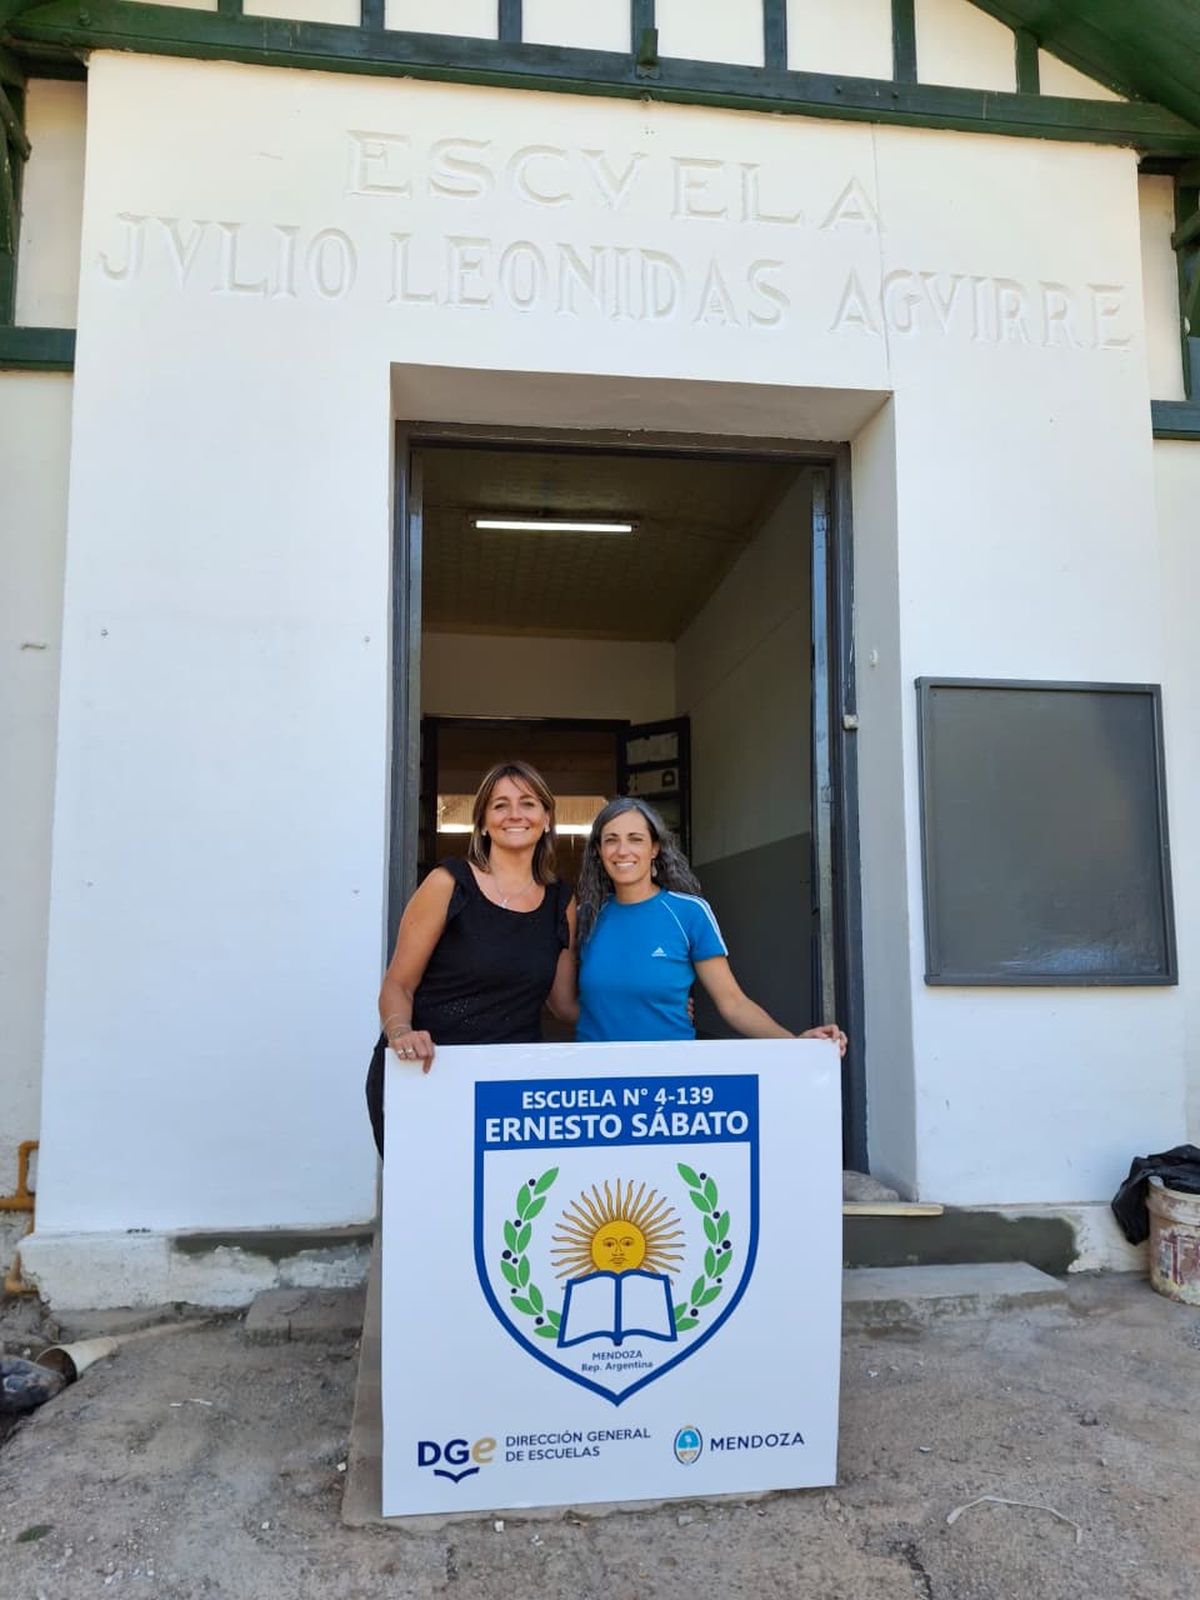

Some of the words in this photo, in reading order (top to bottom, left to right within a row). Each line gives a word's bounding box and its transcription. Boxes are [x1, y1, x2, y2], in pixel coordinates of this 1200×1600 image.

[98, 211, 357, 302] JVLIO
[388, 230, 791, 332] LEONIDAS
[828, 267, 1132, 351] AGVIRRE
[521, 1088, 616, 1110] ESCUELA
[654, 1086, 714, 1106] 4-139
[485, 1114, 623, 1143] ERNESTO
[631, 1106, 749, 1138] SÁBATO
[591, 1350, 643, 1361] MENDOZA
[581, 1363, 602, 1373] Rep.
[605, 1361, 653, 1372] Argentina
[506, 1430, 582, 1447] DIRECCIÓN
[586, 1427, 651, 1443] GENERAL
[710, 1432, 805, 1451] MENDOZA
[417, 1436, 497, 1467] DGe
[505, 1451, 524, 1462] DE
[528, 1446, 600, 1461] ESCUELAS
